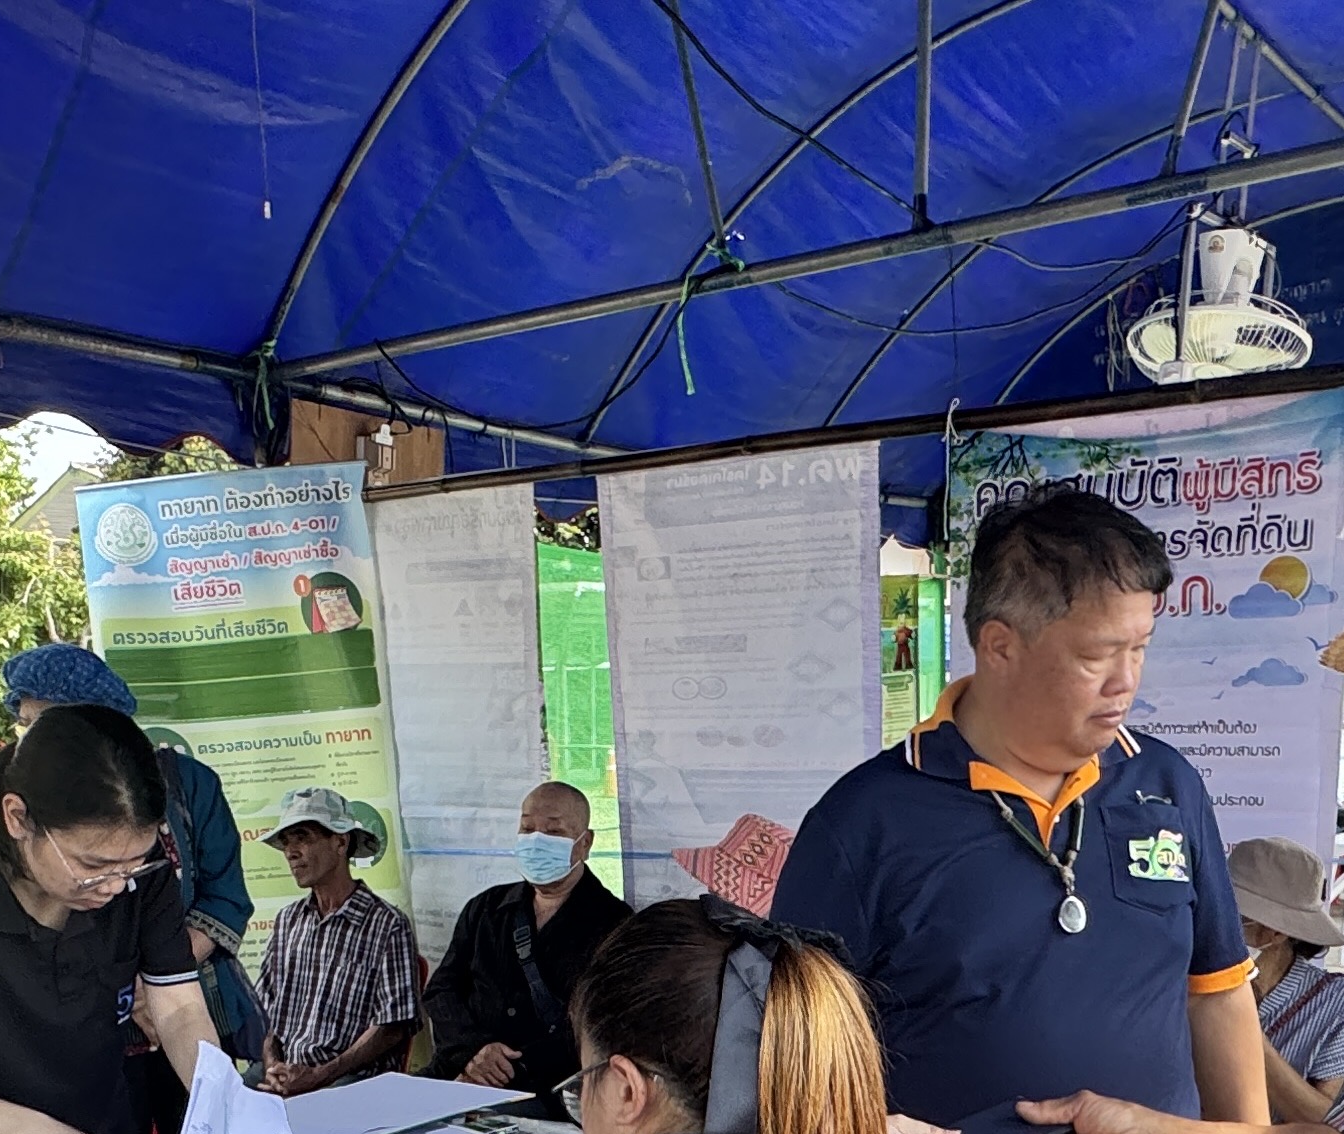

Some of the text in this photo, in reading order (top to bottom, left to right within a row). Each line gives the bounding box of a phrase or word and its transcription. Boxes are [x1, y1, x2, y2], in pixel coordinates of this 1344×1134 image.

[975, 449, 1323, 521] คมบัติผู้มีสิทธิ
[160, 481, 351, 518] ทายาท ต้องทำอย่างไร
[247, 523, 288, 538] ส.ป.ก.
[291, 517, 327, 532] 4-01
[173, 578, 242, 602] เสียชีวิต
[112, 618, 290, 645] ตรวจสอบวันที่เสียชีวิต
[197, 727, 373, 755] ตรวจสอบความเป็น ทายาท
